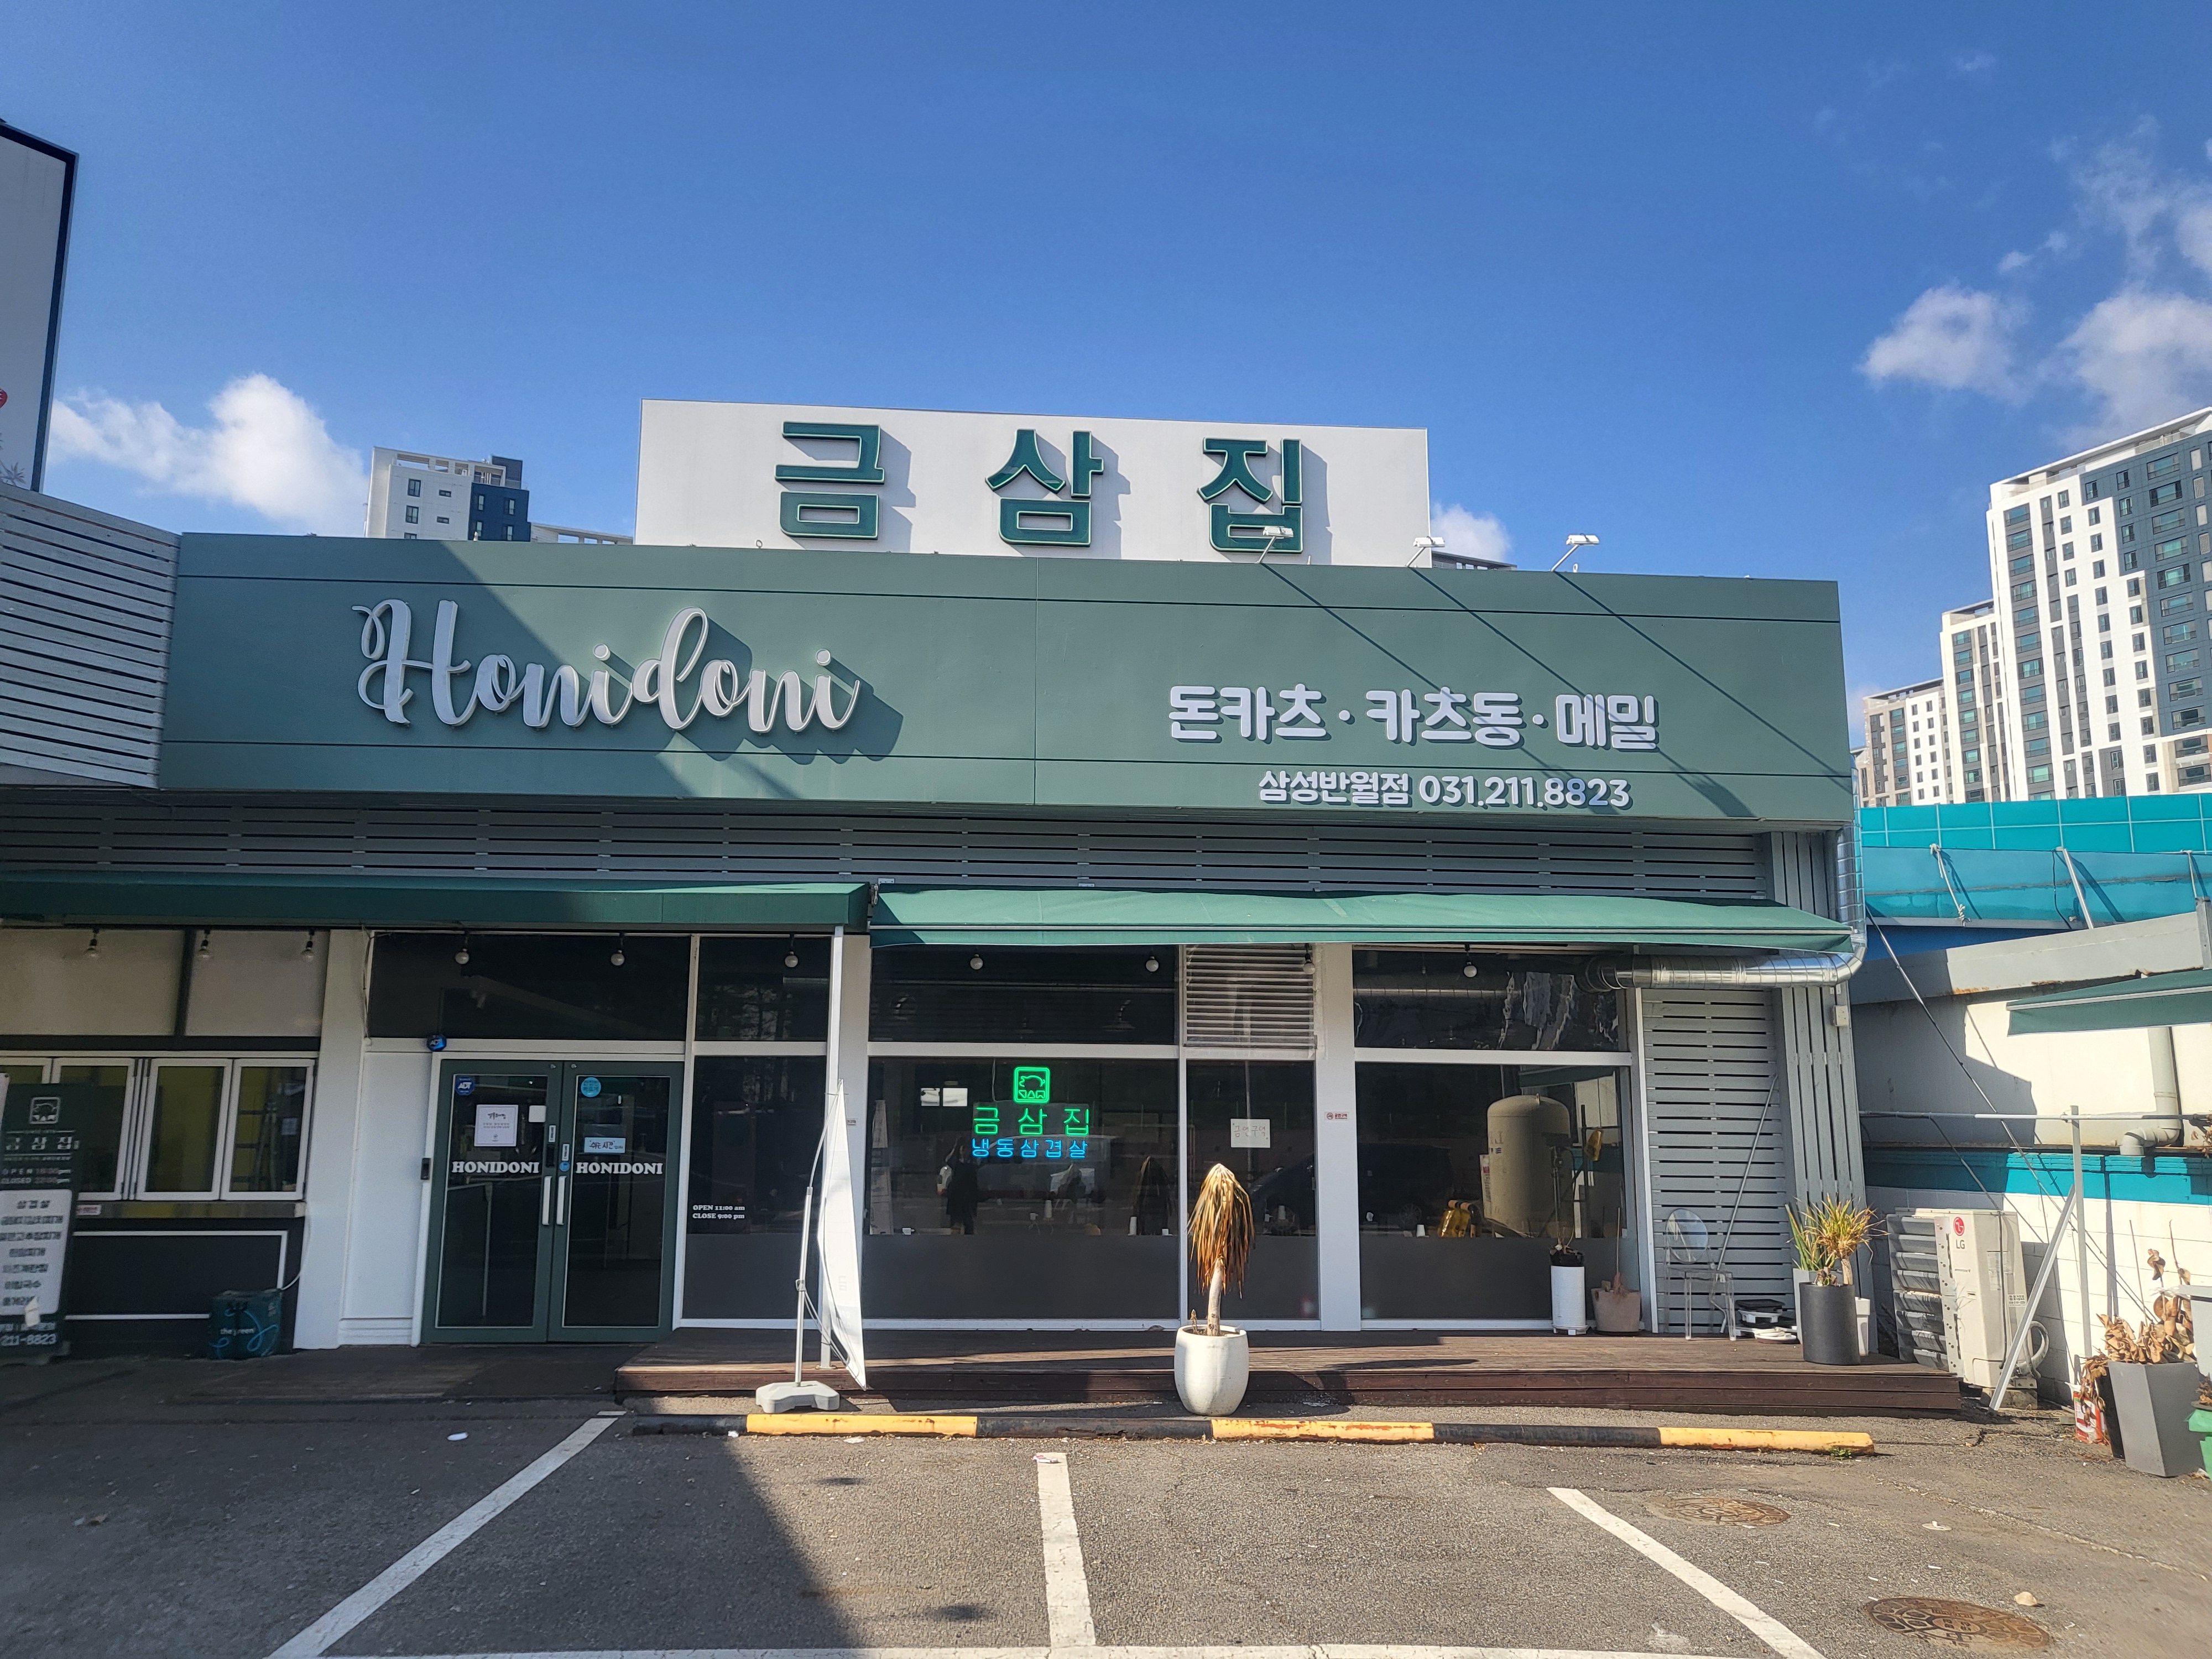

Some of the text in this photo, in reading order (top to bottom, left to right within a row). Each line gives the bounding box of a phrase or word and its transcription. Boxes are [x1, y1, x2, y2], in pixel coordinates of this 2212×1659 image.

[352, 599, 860, 733] Honidoni
[1170, 684, 1327, 741] 돈카츠
[1366, 686, 1524, 747] 카츠동
[1556, 694, 1657, 749] 메밀
[1259, 770, 1631, 807] 삼성반월점 031.211.8823
[971, 1138, 1088, 1159] 냉동삼겹살
[451, 1161, 539, 1173] HONIDONI
[576, 1162, 663, 1174] HONIDONI
[1956, 1239, 1965, 1249] LG
